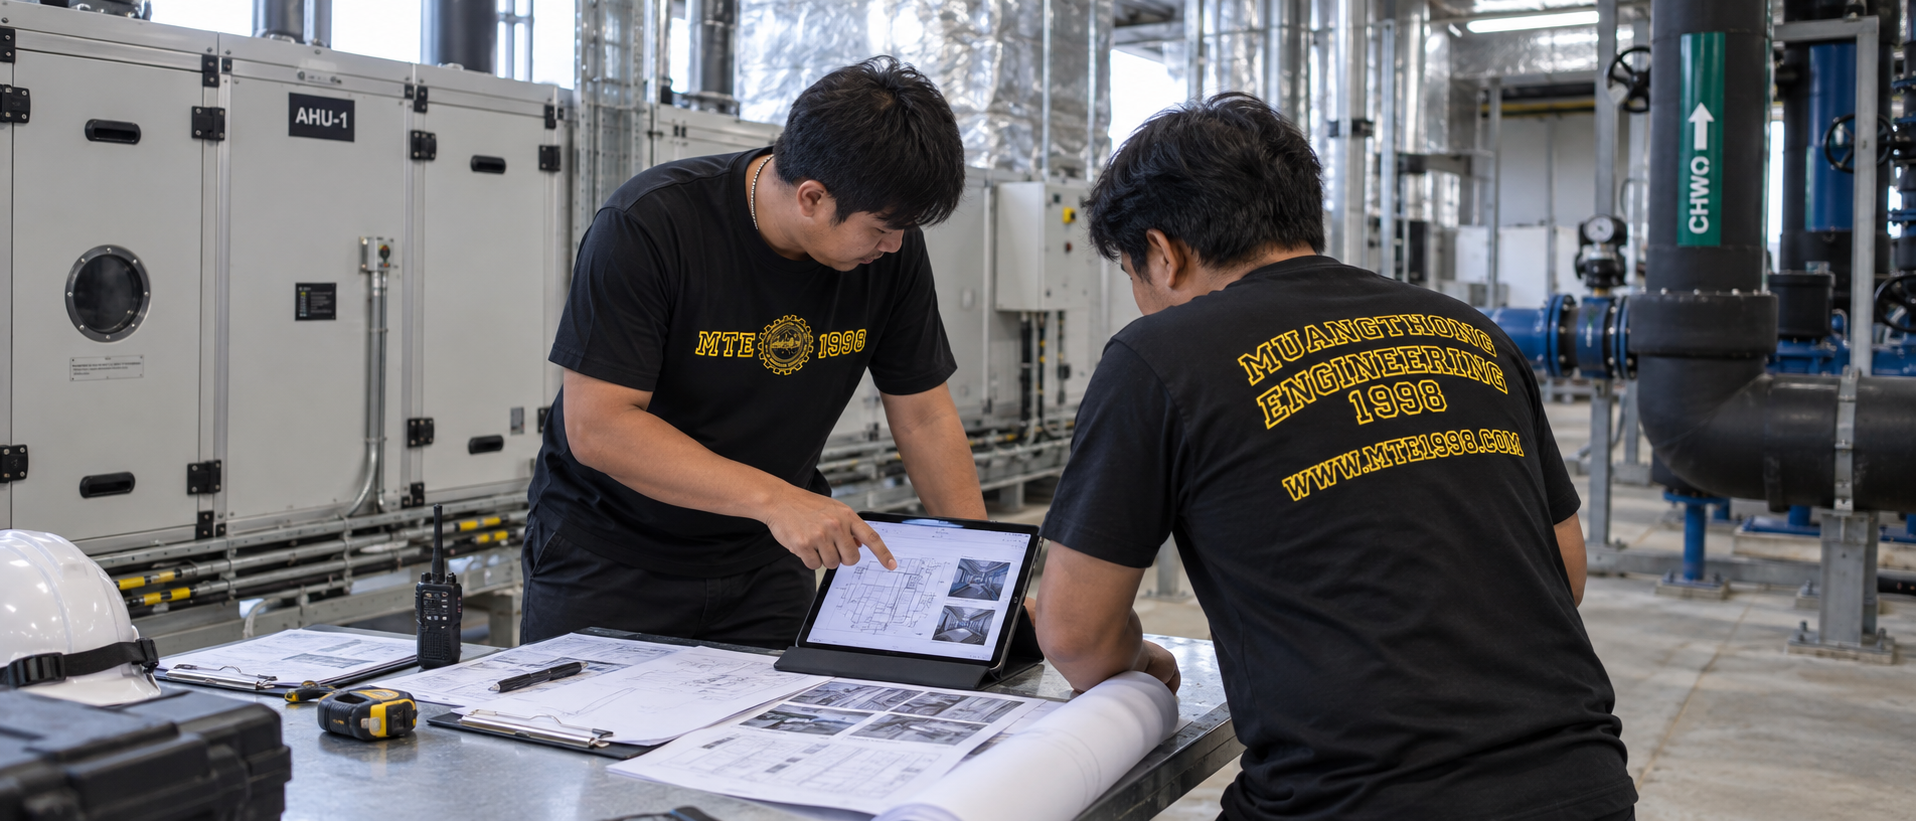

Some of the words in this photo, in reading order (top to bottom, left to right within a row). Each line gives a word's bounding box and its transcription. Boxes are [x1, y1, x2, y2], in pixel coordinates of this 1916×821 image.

[295, 106, 348, 129] AHU-1
[695, 331, 756, 357] MTE
[818, 329, 867, 358] 1998
[1238, 314, 1497, 386] MUANGTHONG
[1257, 345, 1508, 429] ENGINEERING
[1348, 379, 1447, 425] 1998
[1282, 428, 1525, 501] WWW.MTE1998.COM
